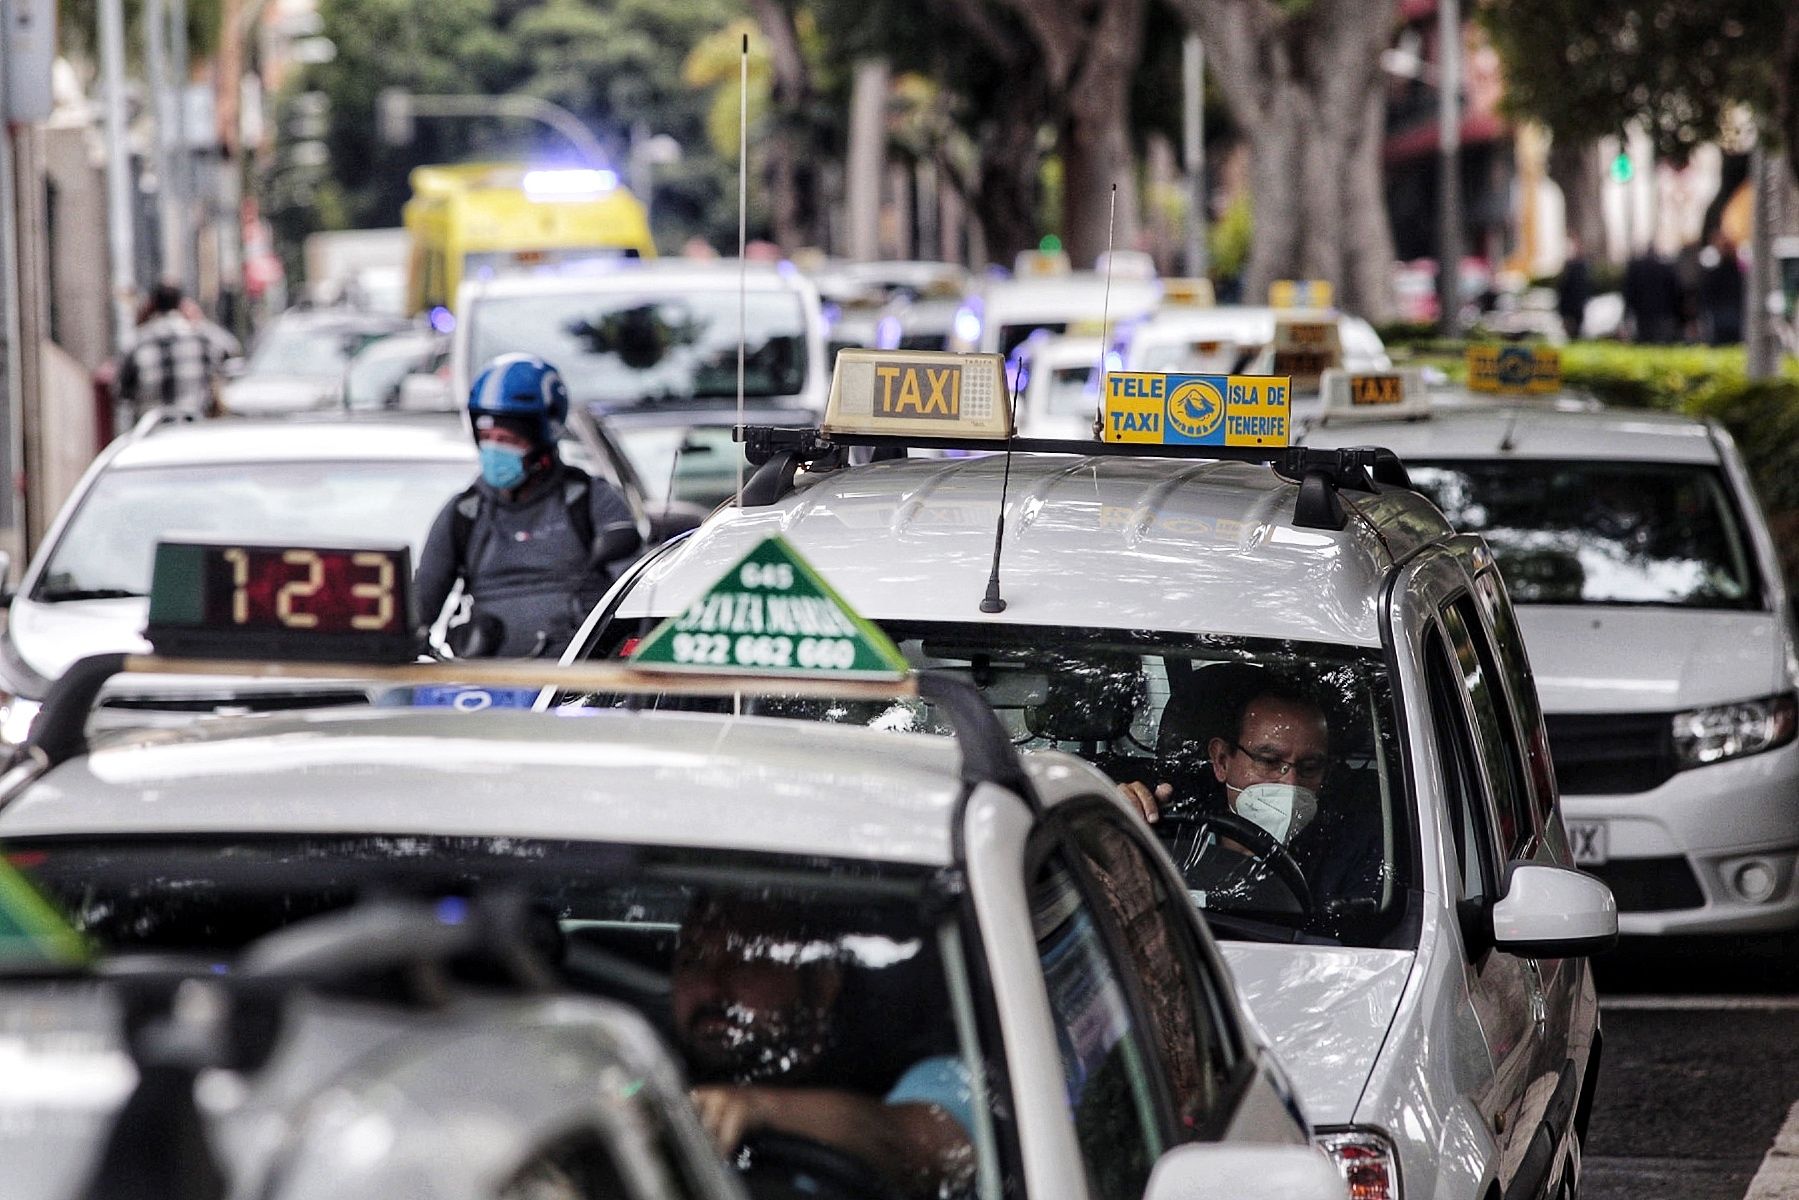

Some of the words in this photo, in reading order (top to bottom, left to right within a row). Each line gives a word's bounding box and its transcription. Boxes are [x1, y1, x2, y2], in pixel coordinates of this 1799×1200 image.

[875, 367, 960, 416] TAXI
[1110, 377, 1163, 398] TELE
[1228, 385, 1259, 405] ISLA
[1267, 386, 1286, 406] DE
[1111, 411, 1160, 432] TAXI
[1228, 415, 1284, 436] TENERIFE
[672, 632, 731, 664] 922
